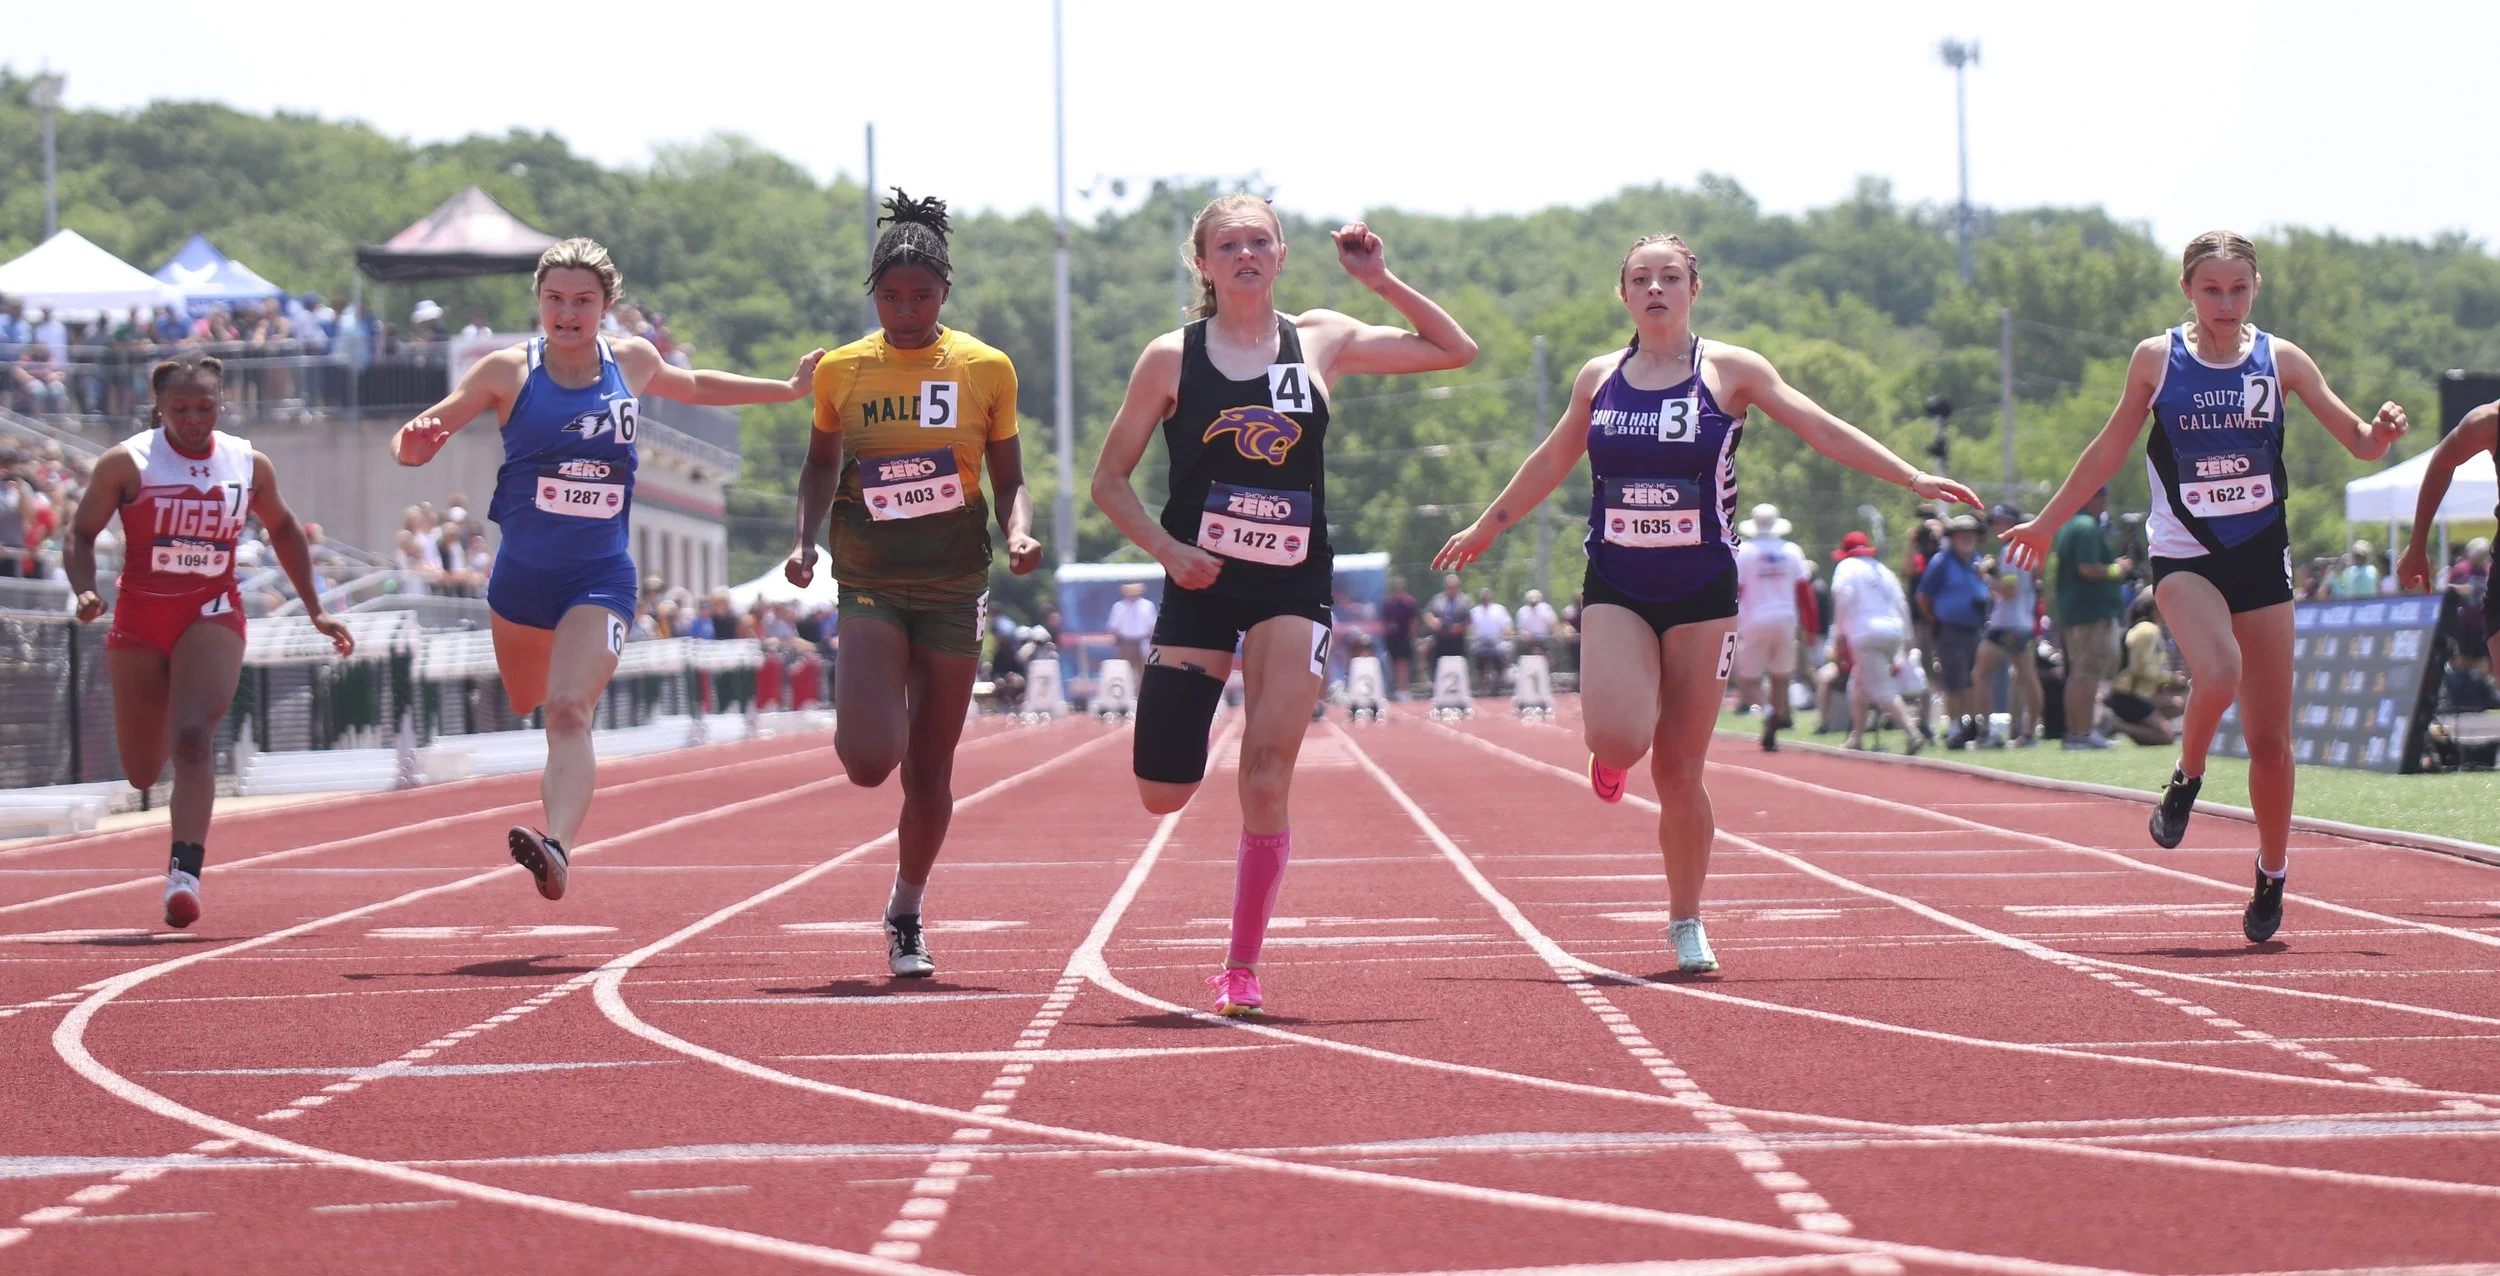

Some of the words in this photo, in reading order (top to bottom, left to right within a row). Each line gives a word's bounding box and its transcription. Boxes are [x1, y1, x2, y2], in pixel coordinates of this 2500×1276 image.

[1276, 367, 1305, 408] 4
[2251, 378, 2269, 418] 2
[861, 395, 921, 428] MALD
[929, 384, 949, 425] 5
[620, 401, 634, 441] 6
[1591, 410, 1628, 426] SOUTH
[1666, 401, 1689, 439] 3
[558, 462, 611, 478] ZERO
[878, 460, 936, 481] ZERO
[2195, 457, 2250, 477] ZERO
[228, 483, 241, 517] 7
[564, 489, 601, 505] 1287
[894, 487, 935, 507] 1403
[1244, 492, 1279, 501] SHOW-ME
[1622, 488, 1679, 504] ZERO
[2207, 486, 2246, 503] 1622
[1227, 495, 1291, 518] ZERO
[1632, 519, 1671, 534] 1635
[1233, 528, 1277, 550] 1472
[177, 554, 209, 567] 1094
[613, 622, 623, 656] 6
[1314, 630, 1330, 677] 4
[1720, 635, 1735, 677] 3
